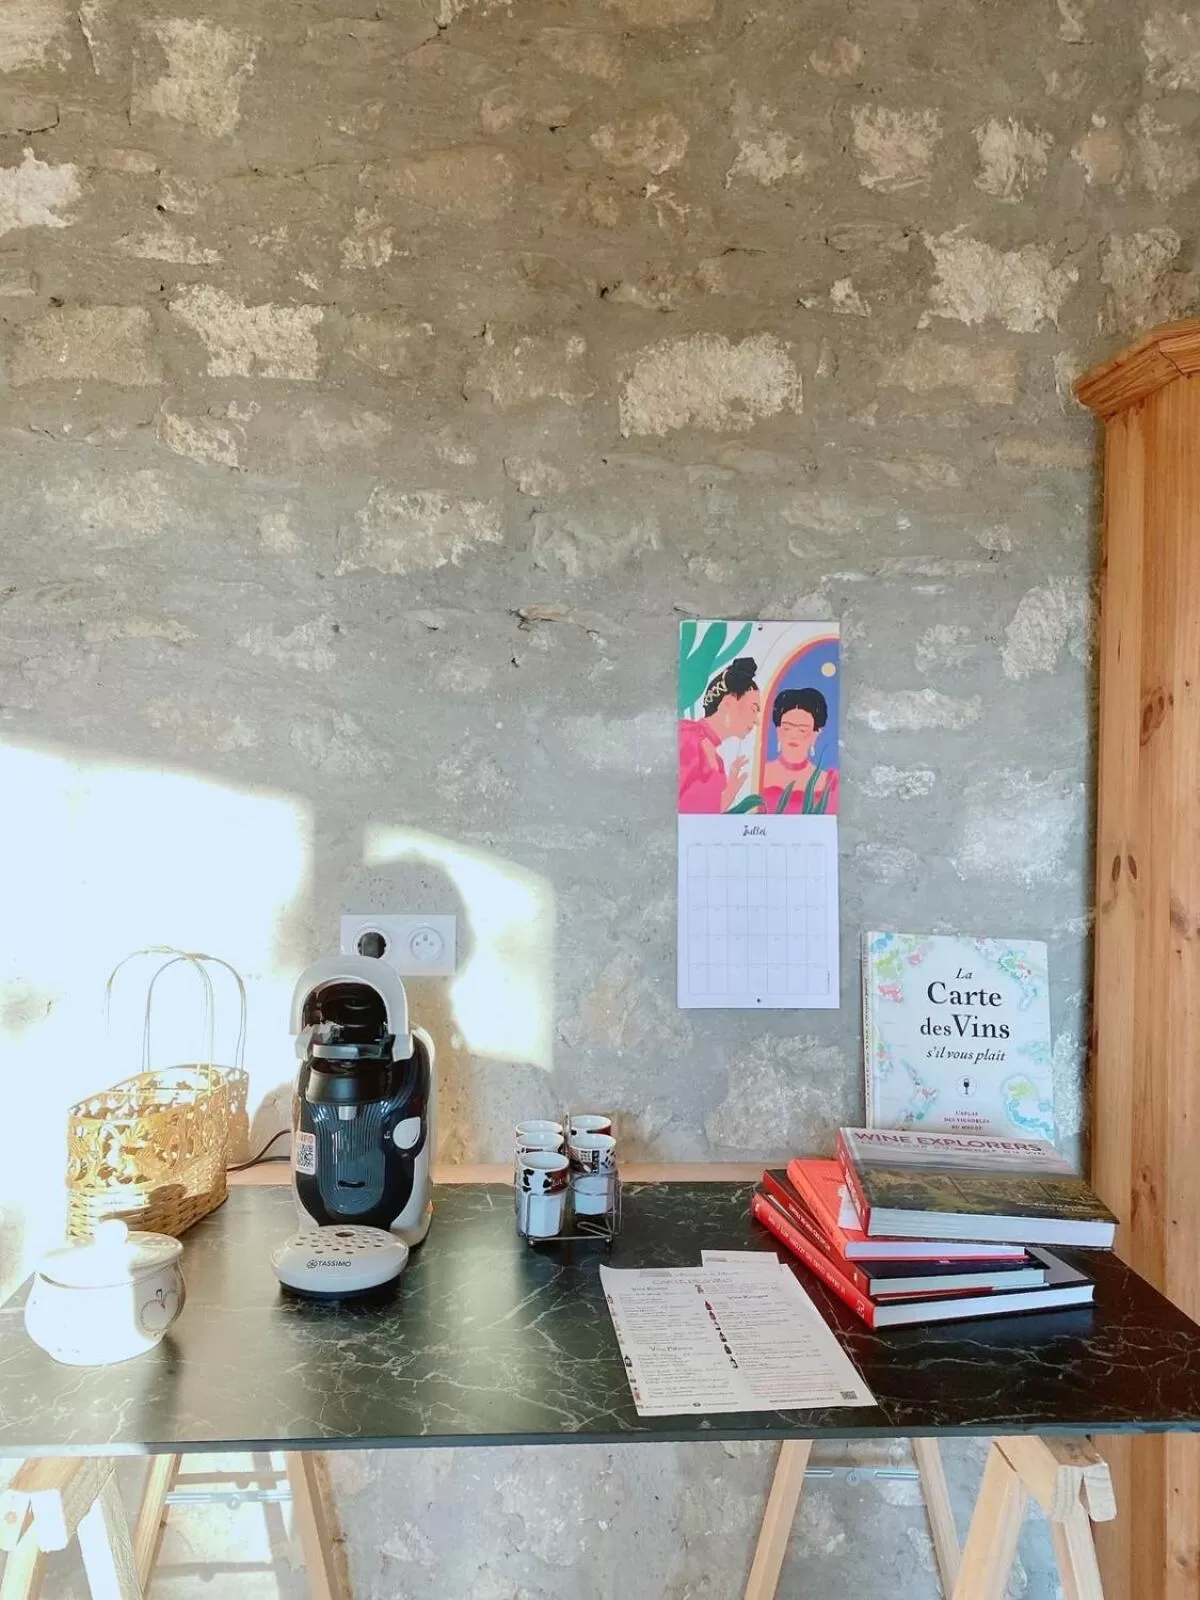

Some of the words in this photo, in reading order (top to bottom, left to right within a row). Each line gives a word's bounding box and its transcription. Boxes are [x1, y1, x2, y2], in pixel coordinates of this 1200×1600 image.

[956, 967, 973, 980] La
[927, 981, 1003, 1007] Carte
[920, 1016, 951, 1037] des
[951, 1013, 1010, 1040] Vins
[926, 1046, 947, 1059] s'il
[947, 1050, 974, 1061] vous
[854, 1131, 911, 1144] WINE
[917, 1136, 1042, 1152] EXPLORERS
[318, 1260, 352, 1268] TASSIMO
